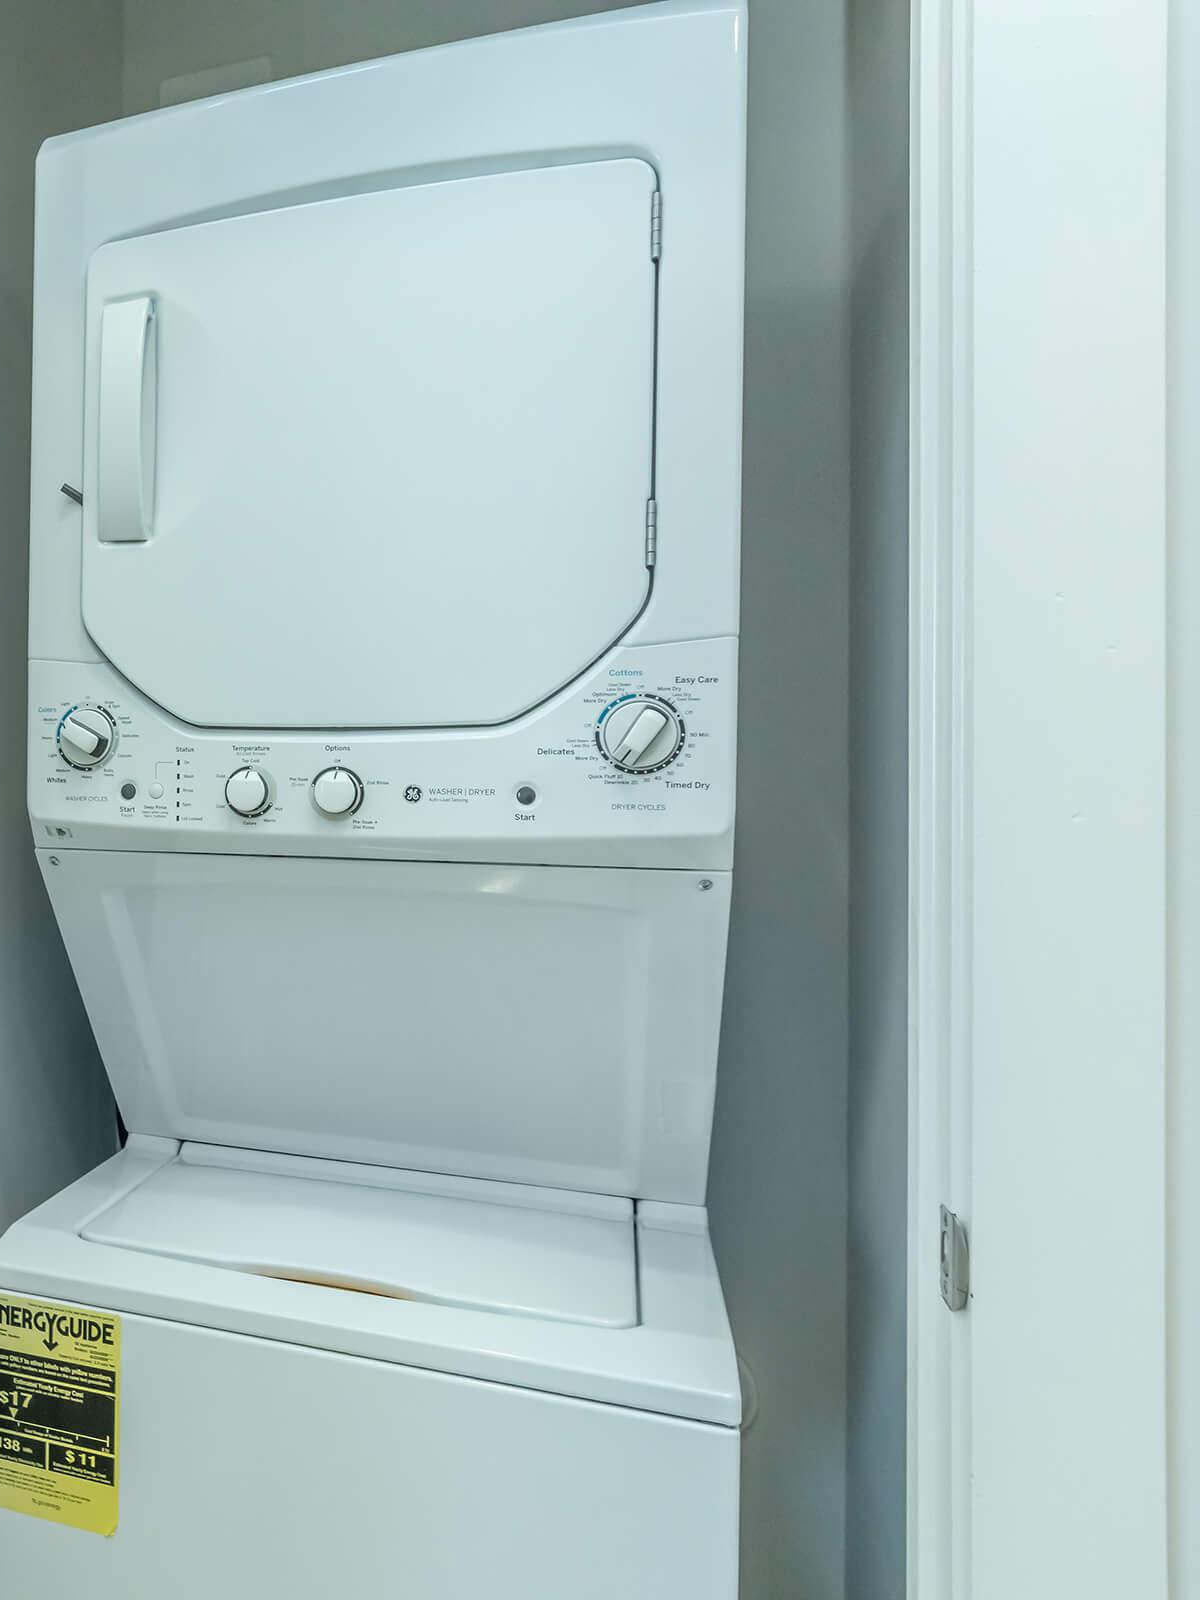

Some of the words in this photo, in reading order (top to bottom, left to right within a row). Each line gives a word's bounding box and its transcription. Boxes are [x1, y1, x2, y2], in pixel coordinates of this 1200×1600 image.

[608, 669, 643, 677] Cottons
[675, 676, 696, 685] Easy
[697, 676, 719, 684] Care
[324, 744, 351, 752] Options
[665, 781, 693, 789] Timed
[694, 781, 711, 790] Dry
[429, 787, 463, 796] WASHER
[468, 788, 496, 796] DRYER
[119, 806, 136, 814] Start
[514, 813, 536, 821] Start
[9, 1355, 24, 1364] ONLY
[53, 1386, 72, 1397] Energy
[71, 1390, 84, 1398] Cost
